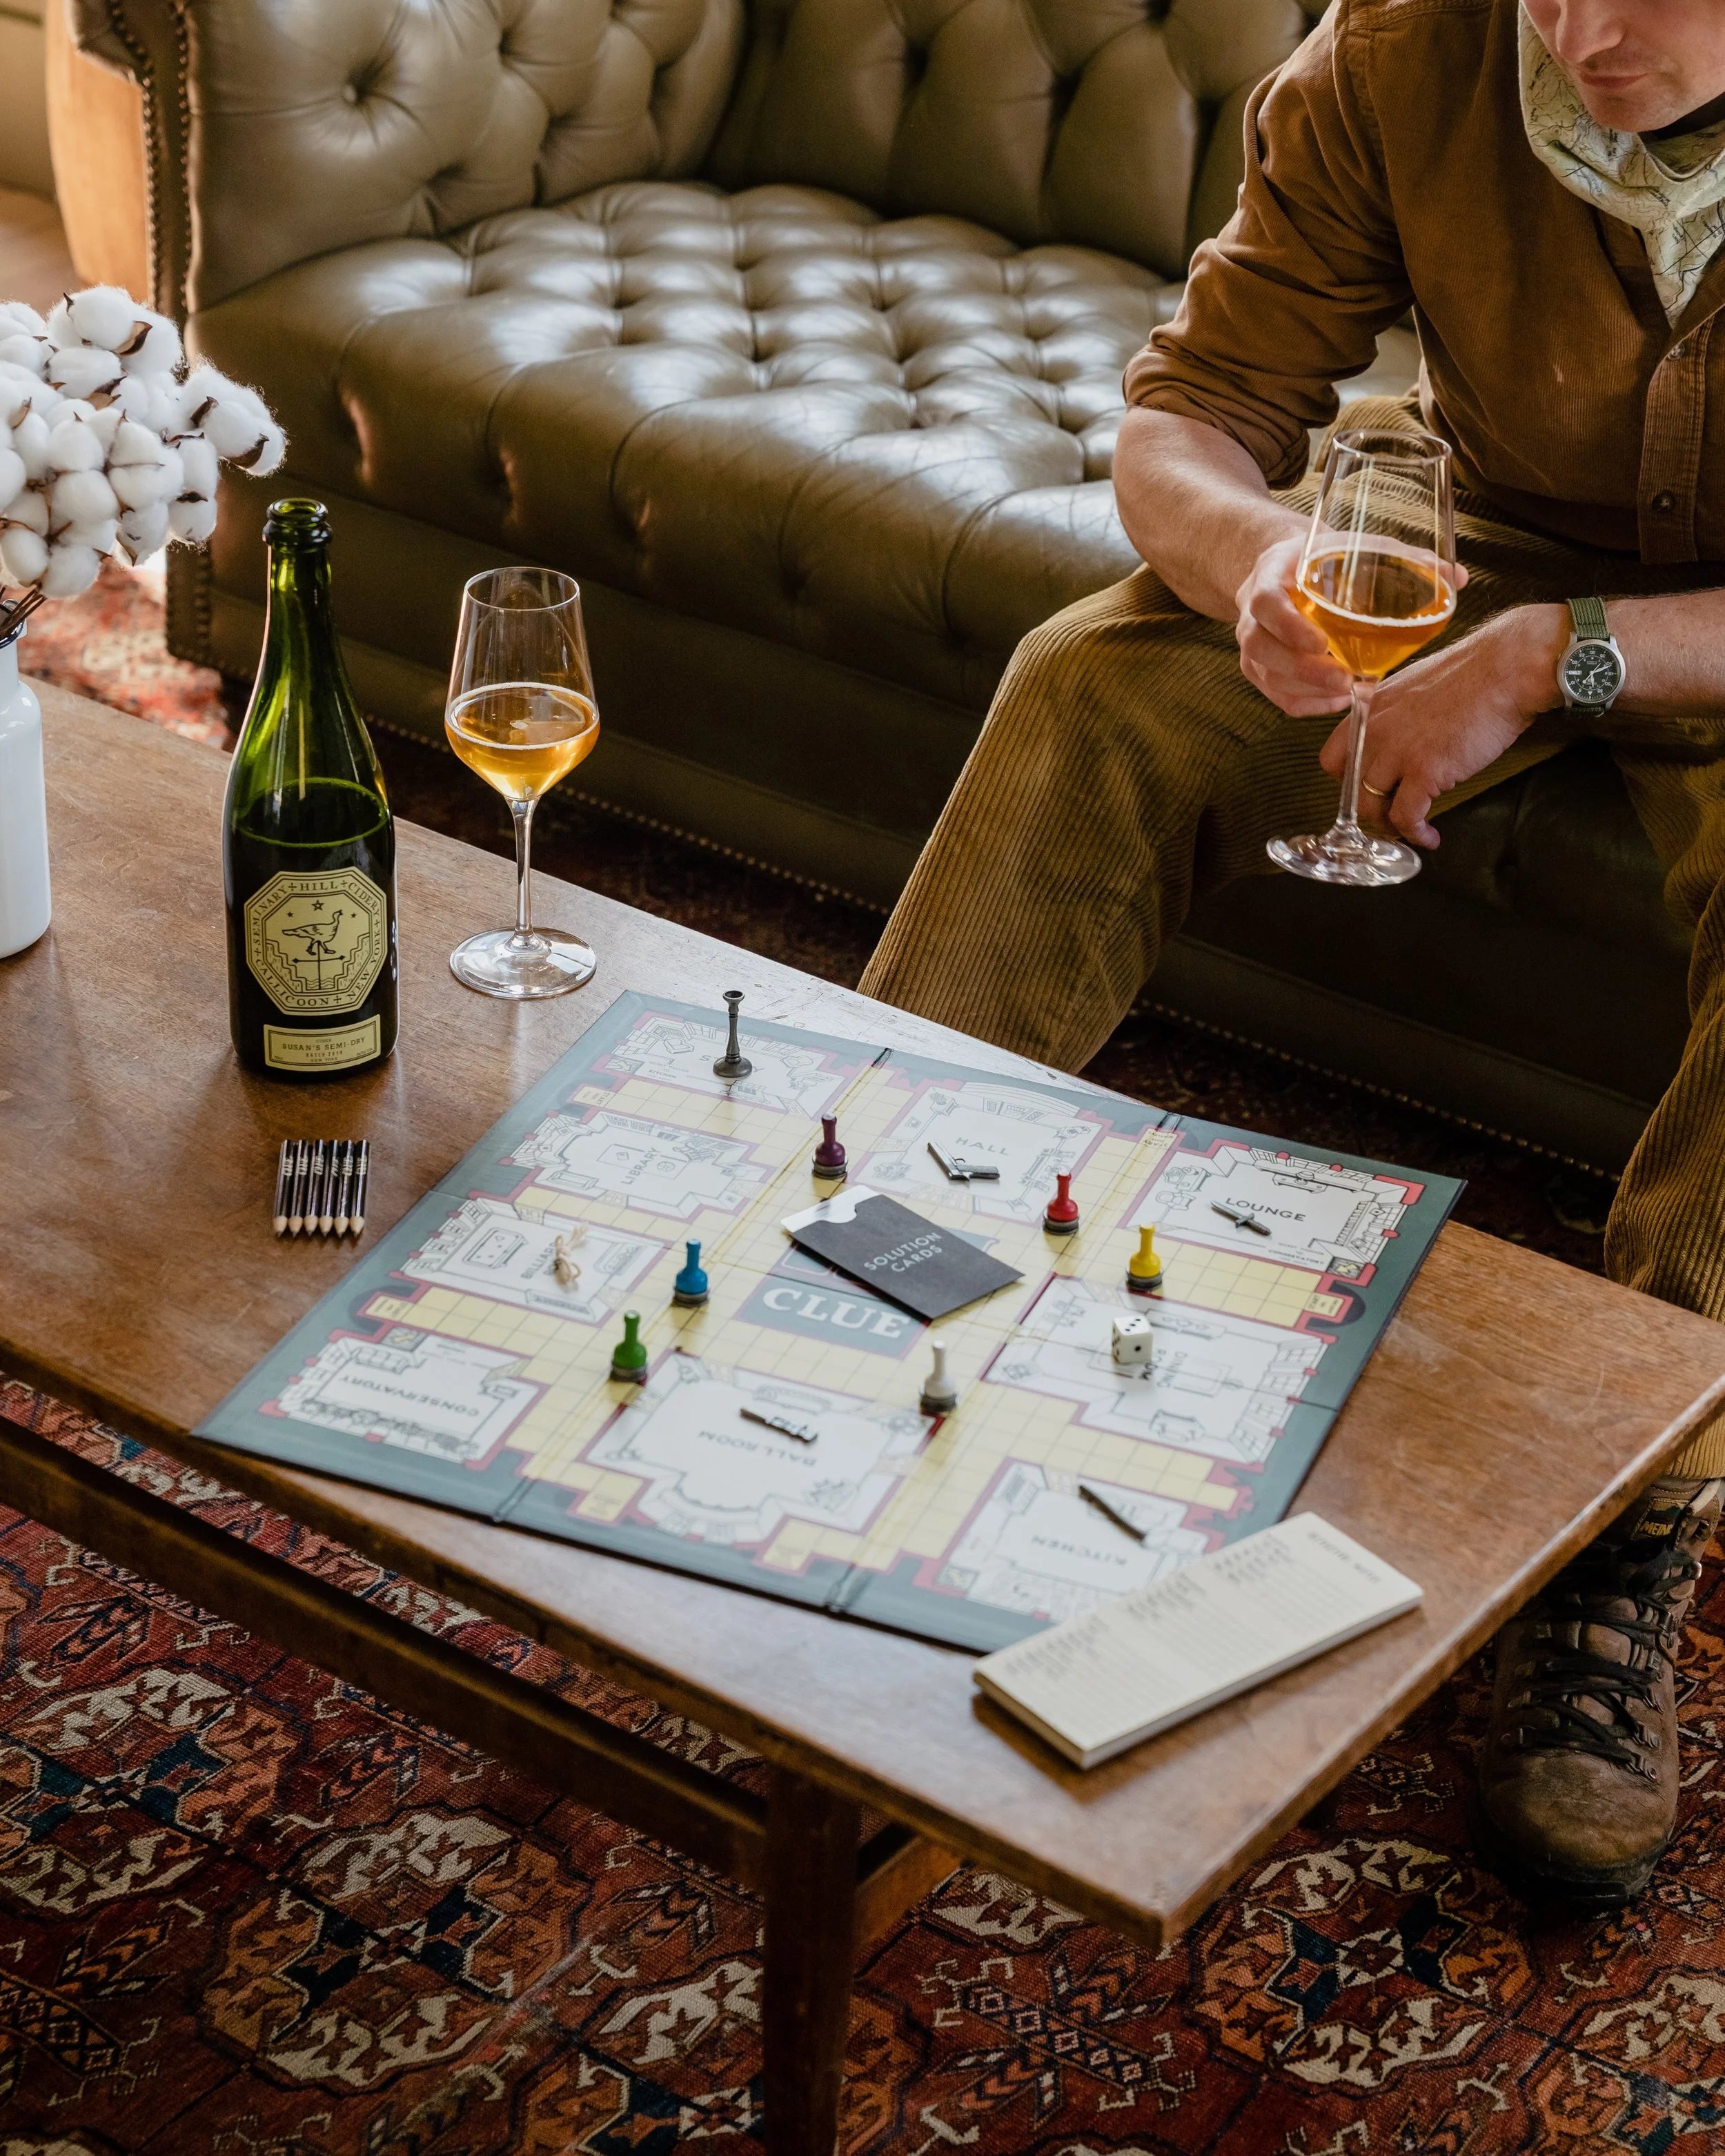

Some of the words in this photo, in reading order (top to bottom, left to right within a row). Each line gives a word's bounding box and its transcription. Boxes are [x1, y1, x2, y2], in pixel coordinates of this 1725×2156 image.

[253, 885, 287, 946] SEMINARY
[299, 881, 338, 891] HILL
[348, 882, 380, 916] CIDERY
[256, 959, 330, 1006] CALLICOON
[346, 971, 370, 1000] NEW
[371, 929, 380, 964] YORK
[282, 1042, 321, 1051] SUSAN'S
[324, 1036, 365, 1050] SEMI-DRY
[956, 1137, 1009, 1156] HALL
[621, 1147, 662, 1185] LIBRARY
[1225, 1197, 1306, 1222] LOUNGE
[520, 1241, 555, 1279] BILLIAR
[864, 1232, 942, 1271] SOLUTION
[891, 1245, 943, 1273] CARDS
[762, 1287, 911, 1338] CLUE
[343, 1376, 480, 1417] CONSERVATORY
[699, 1430, 758, 1453] ROOM
[764, 1445, 817, 1467] BALL
[1032, 1534, 1127, 1566] KITCHEN
